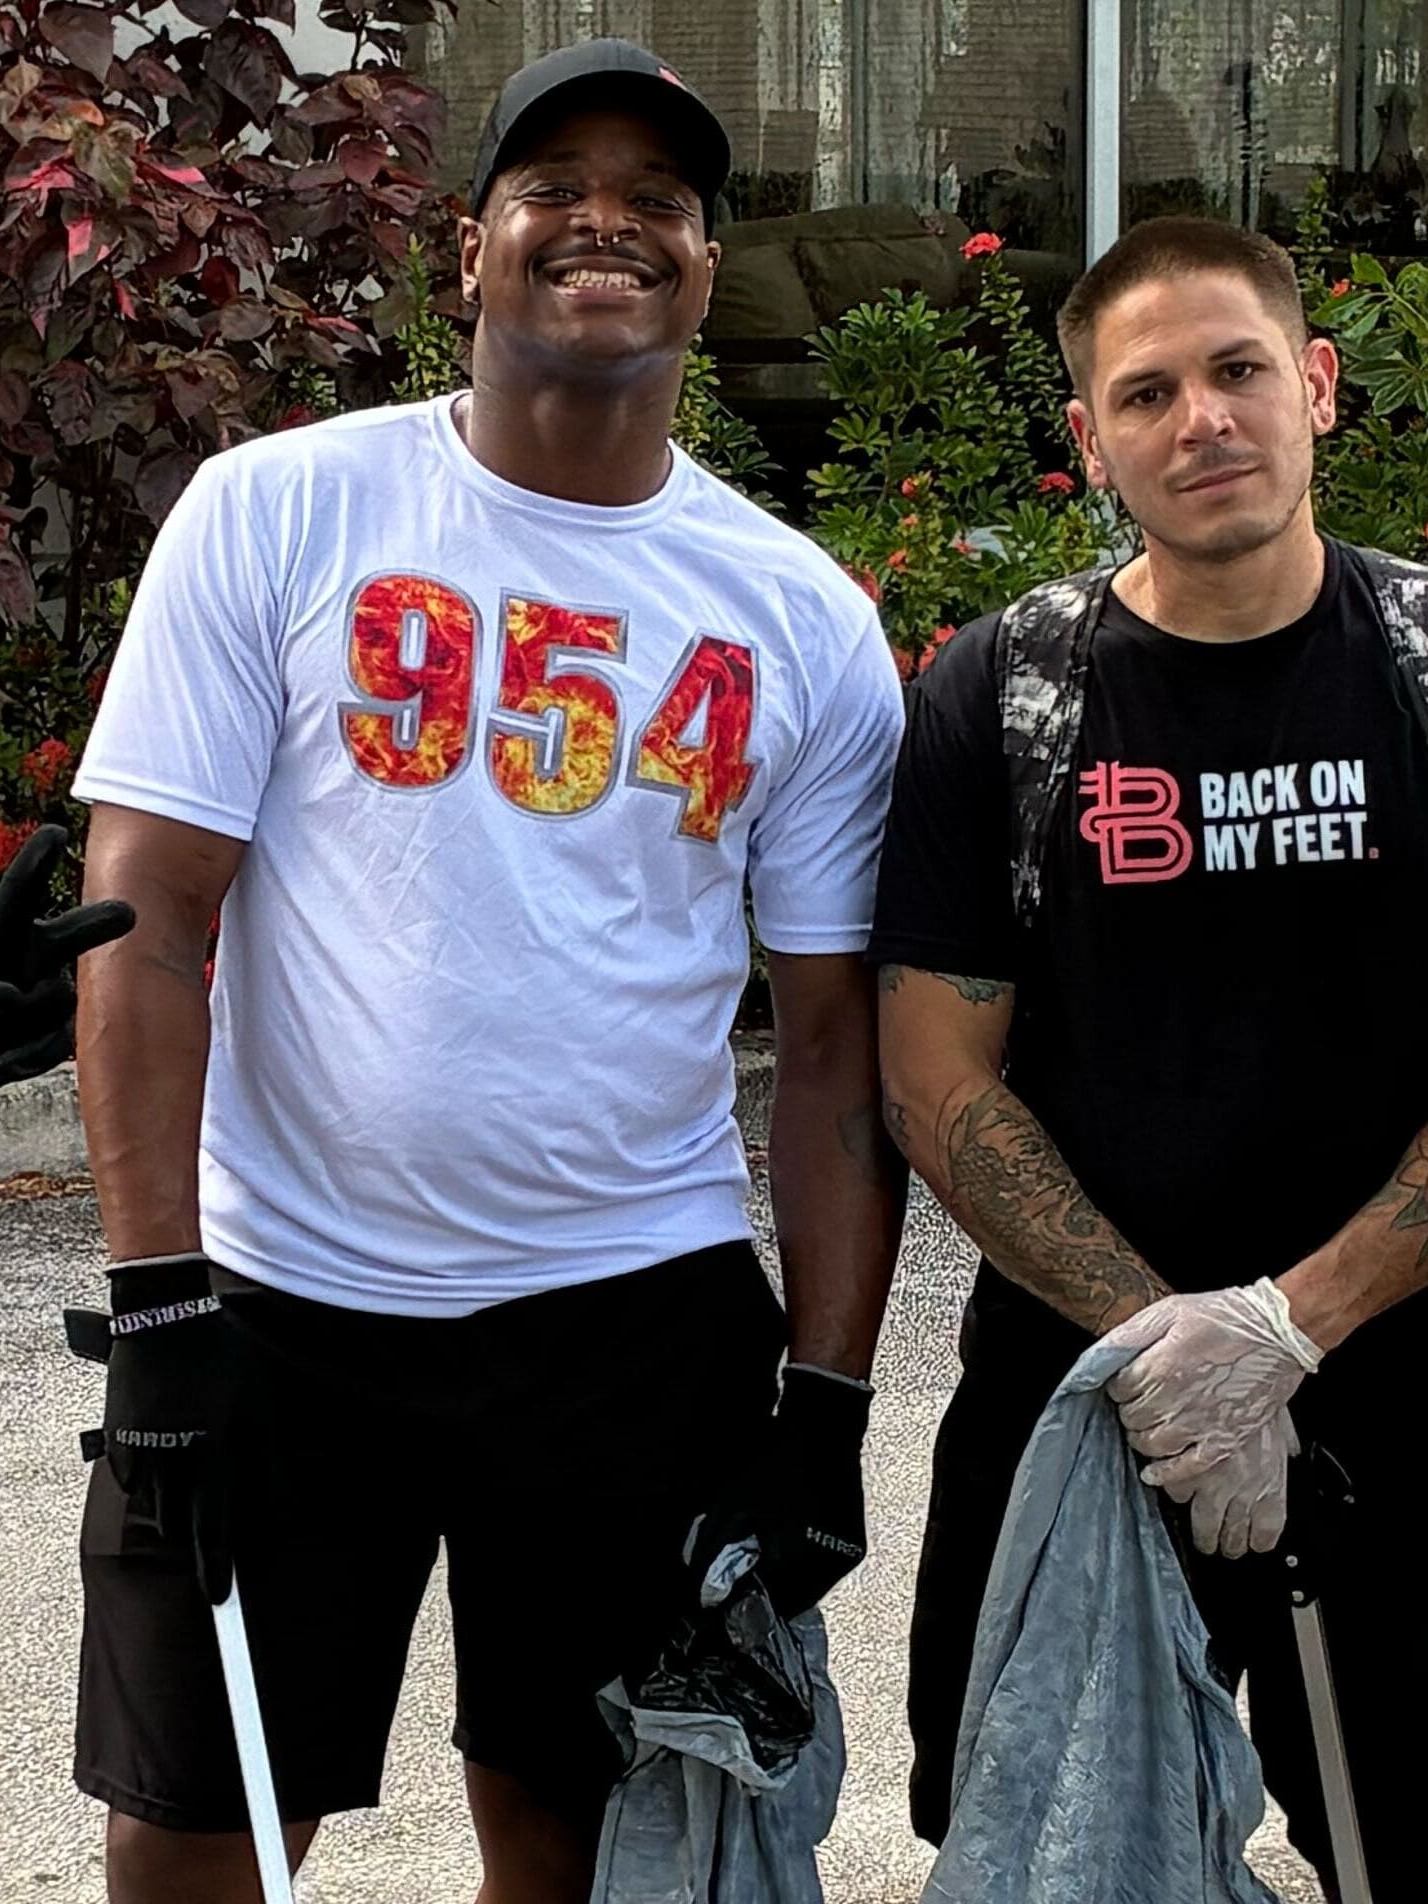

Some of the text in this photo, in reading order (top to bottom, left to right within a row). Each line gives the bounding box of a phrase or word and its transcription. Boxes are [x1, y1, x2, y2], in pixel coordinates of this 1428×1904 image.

[336, 568, 764, 844] 954
[1199, 759, 1367, 819] BACK ON
[1202, 810, 1380, 872] MY FEET.
[115, 1427, 195, 1448] HARDY
